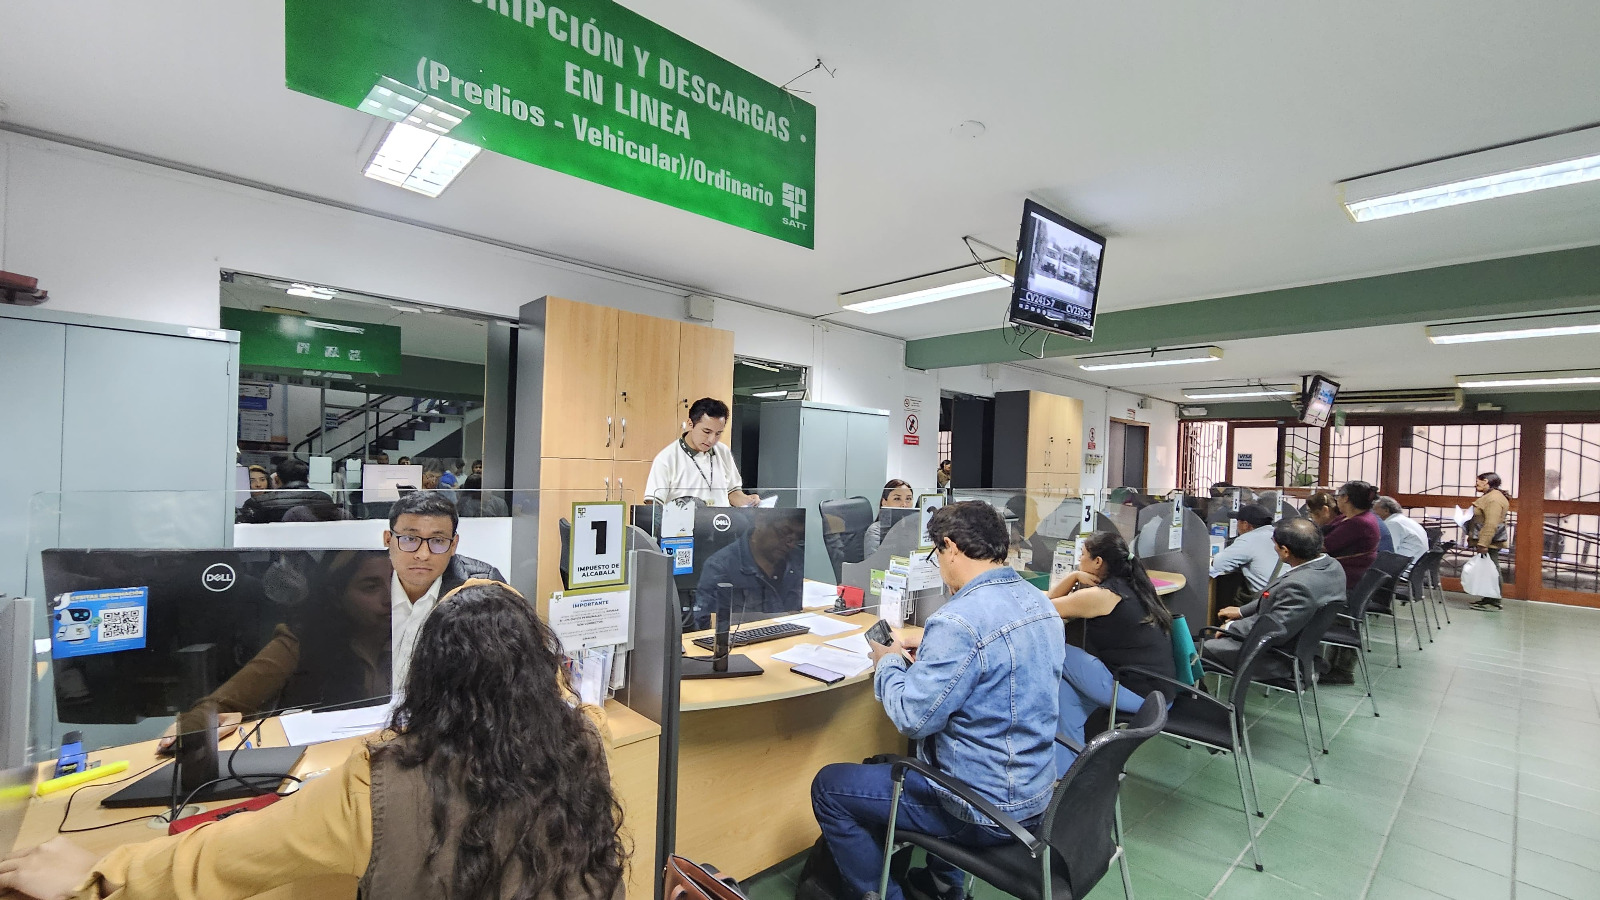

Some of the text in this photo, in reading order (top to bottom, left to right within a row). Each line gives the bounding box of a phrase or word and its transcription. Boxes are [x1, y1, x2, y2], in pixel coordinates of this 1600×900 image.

[472, 0, 790, 142] IPCIÓN Y DESCARGAS
[565, 60, 691, 140] EN LINEA
[416, 56, 546, 127] (Predios
[572, 113, 774, 207] Vehicular)/Ordinario
[782, 217, 808, 231] SATT
[1084, 505, 1091, 522] 3
[1175, 499, 1180, 513] 4
[591, 520, 607, 555] 1
[577, 564, 610, 572] IMPUESTO
[206, 573, 232, 582] DELL
[572, 600, 609, 609] IMPORTANTE
